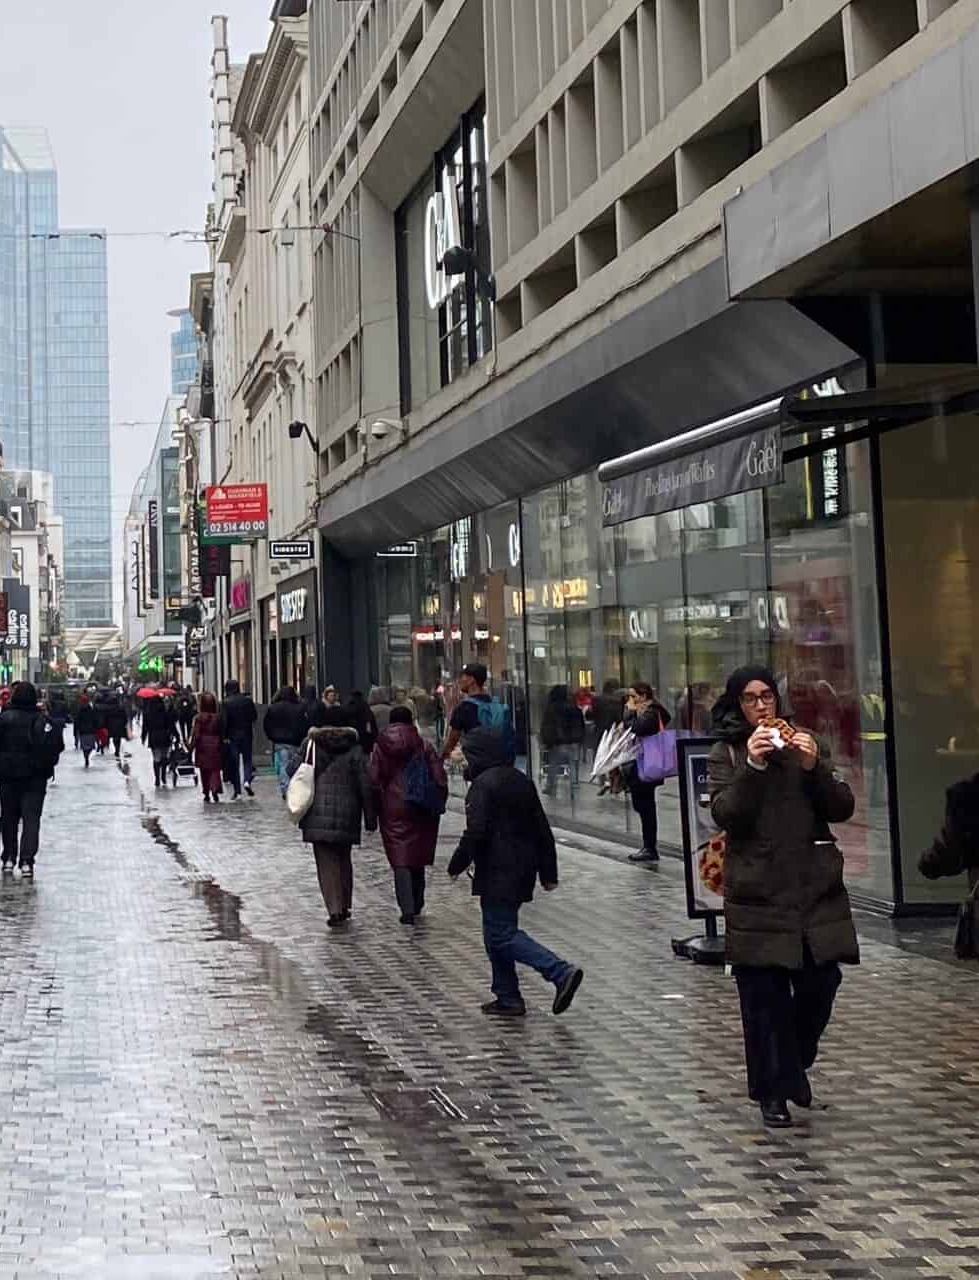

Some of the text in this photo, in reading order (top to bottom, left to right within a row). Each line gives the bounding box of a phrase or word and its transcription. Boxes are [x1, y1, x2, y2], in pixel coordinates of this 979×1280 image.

[210, 520, 266, 532] 02 514 40 00
